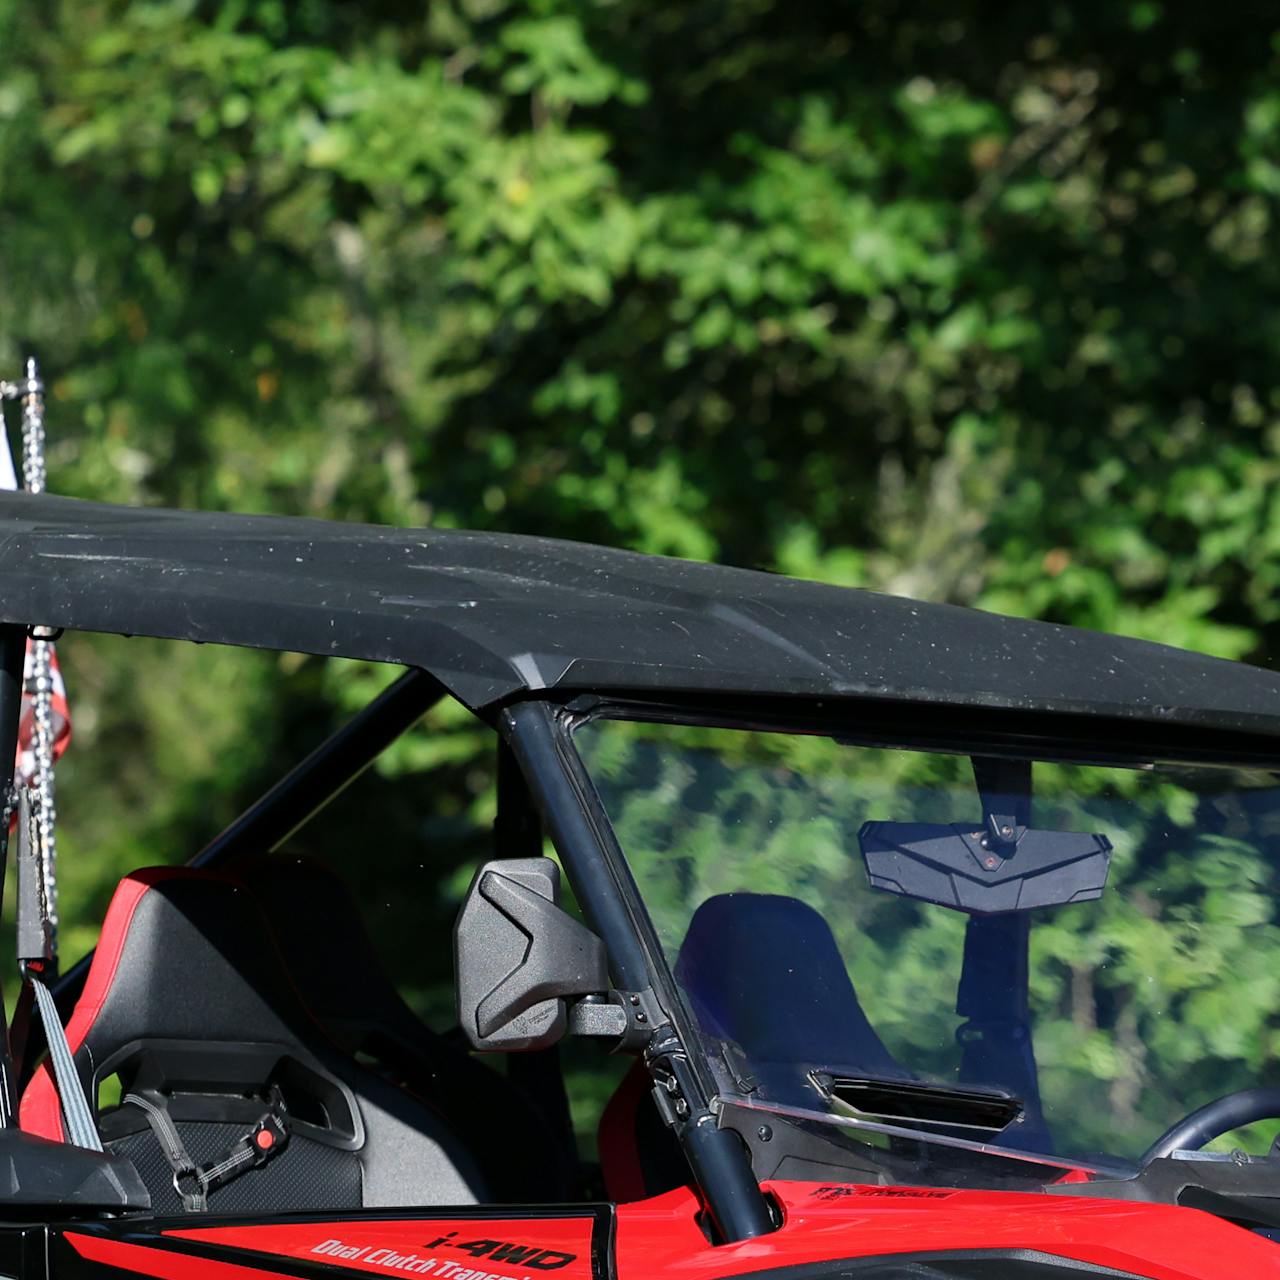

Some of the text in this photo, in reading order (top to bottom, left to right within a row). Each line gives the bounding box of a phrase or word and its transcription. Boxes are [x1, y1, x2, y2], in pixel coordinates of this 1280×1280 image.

[310, 1239, 372, 1260] Dual
[363, 1248, 437, 1274] Clutch
[423, 1231, 578, 1271] i-4WD
